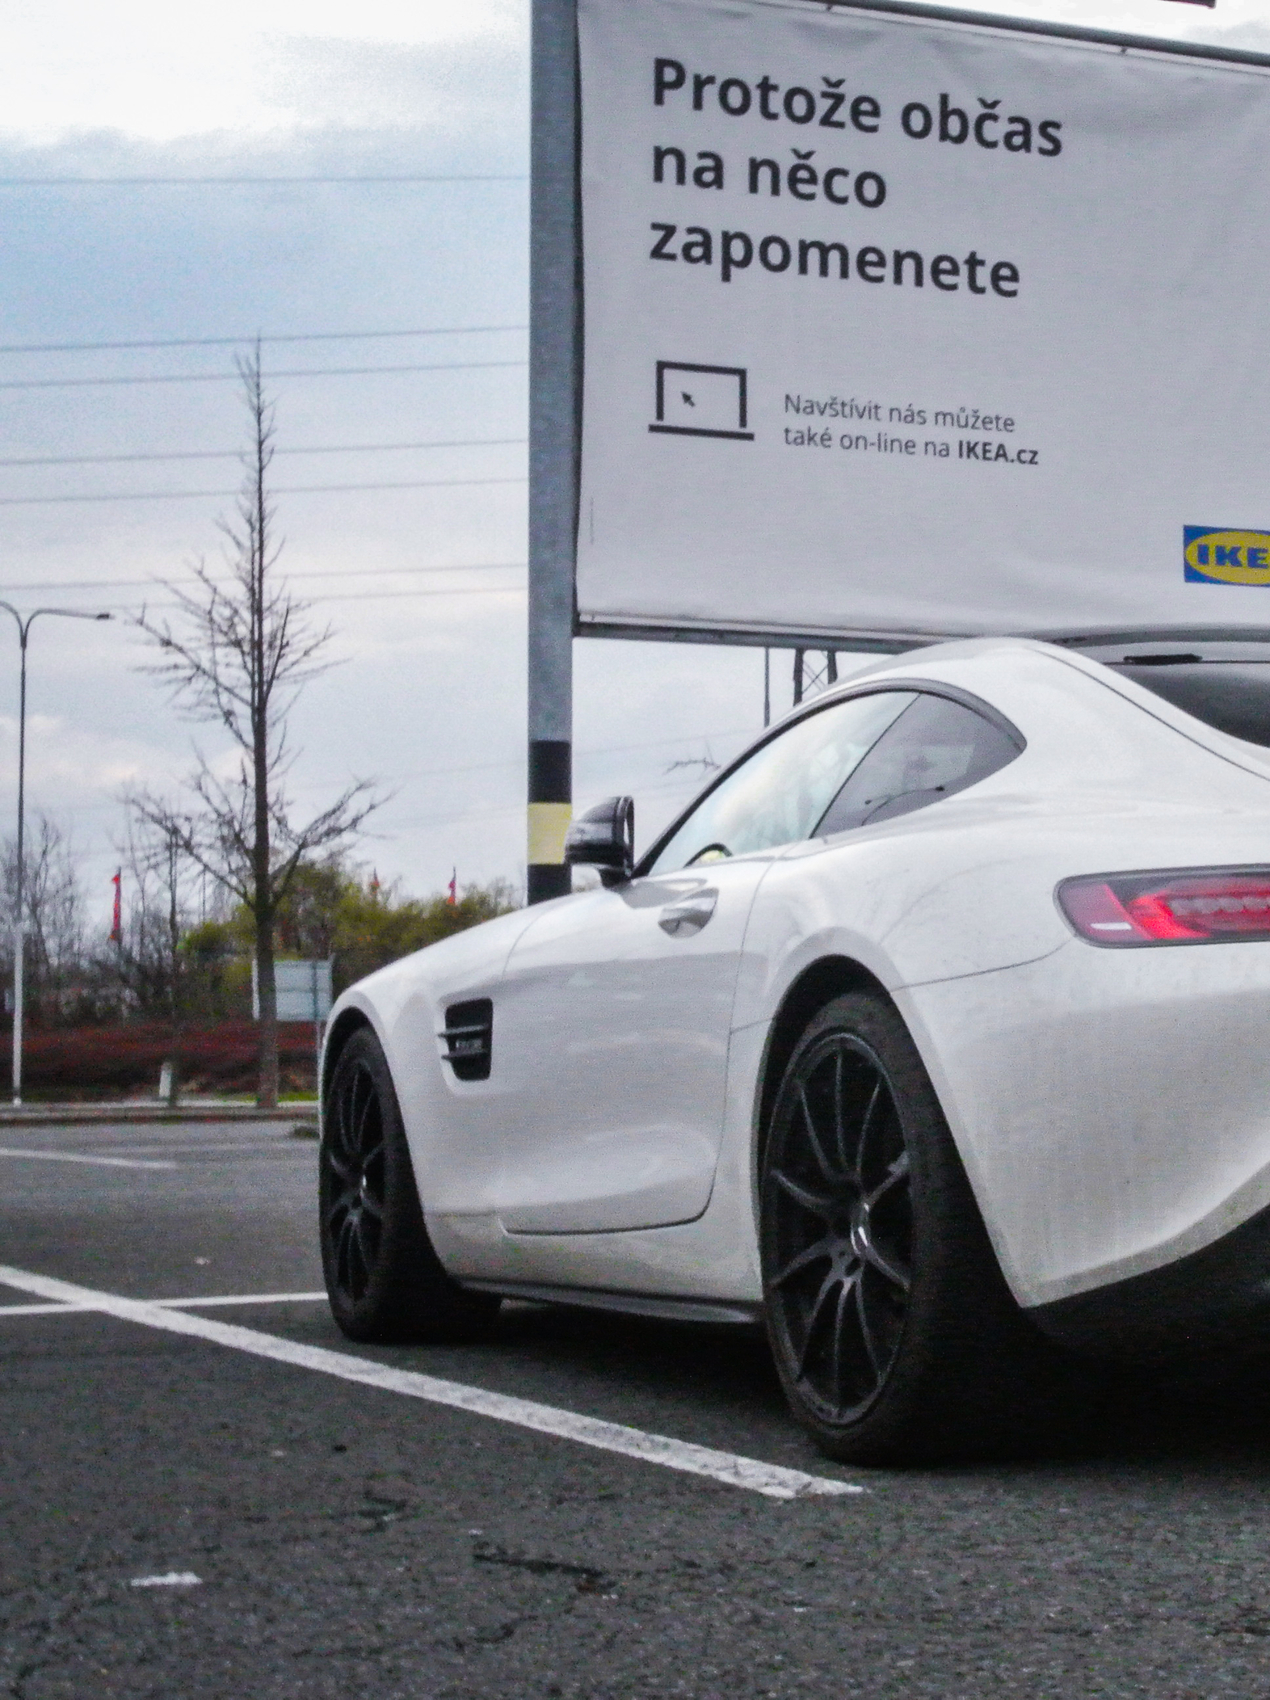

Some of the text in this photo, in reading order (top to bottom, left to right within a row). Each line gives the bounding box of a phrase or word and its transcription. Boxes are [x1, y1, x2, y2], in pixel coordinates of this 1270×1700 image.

[652, 56, 1063, 158] Protože občas
[652, 145, 887, 209] na něco
[649, 221, 1020, 298] zapomenete
[784, 392, 1016, 434] Navštívit nás můžete
[784, 425, 1039, 466] také on-line na IKEA.cz
